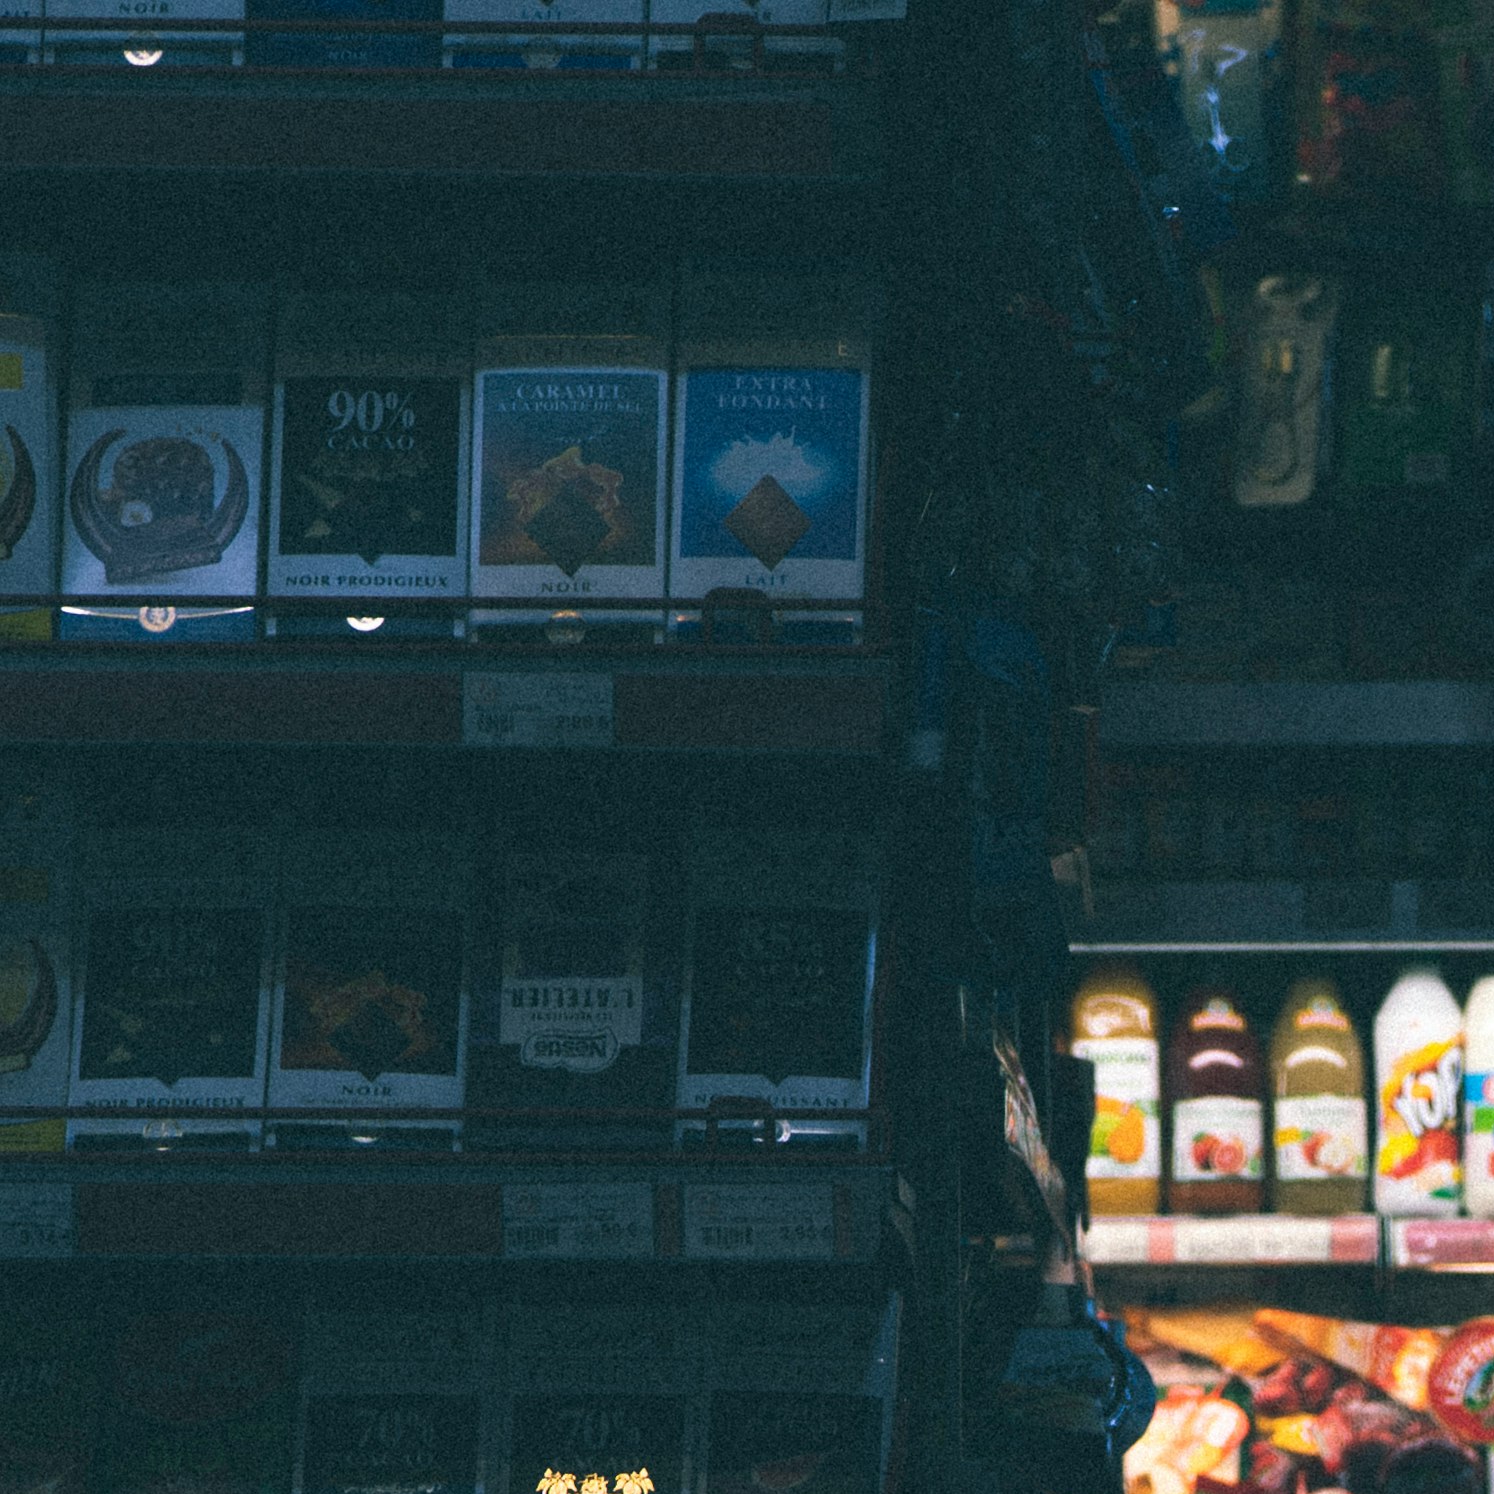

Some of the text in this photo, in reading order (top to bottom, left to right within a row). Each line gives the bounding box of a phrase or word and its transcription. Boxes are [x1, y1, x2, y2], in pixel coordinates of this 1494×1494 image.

[119, 3, 170, 14] NOIR
[734, 374, 813, 390] EXTRA
[516, 383, 621, 400] CARAMEL
[717, 393, 829, 410] FONDANT
[327, 389, 415, 433] 90%
[327, 436, 416, 451] CACAO
[286, 574, 448, 588] NOIR PRODIGIEUX
[541, 581, 592, 593] NOIR
[744, 574, 788, 586] LAIT
[511, 985, 635, 1008] L'ATELIER
[342, 1085, 392, 1097] NOIR
[85, 1097, 245, 1109] NOIR PRODIGIEUX
[356, 1409, 435, 1448] 70%
[557, 1409, 639, 1449] 70%
